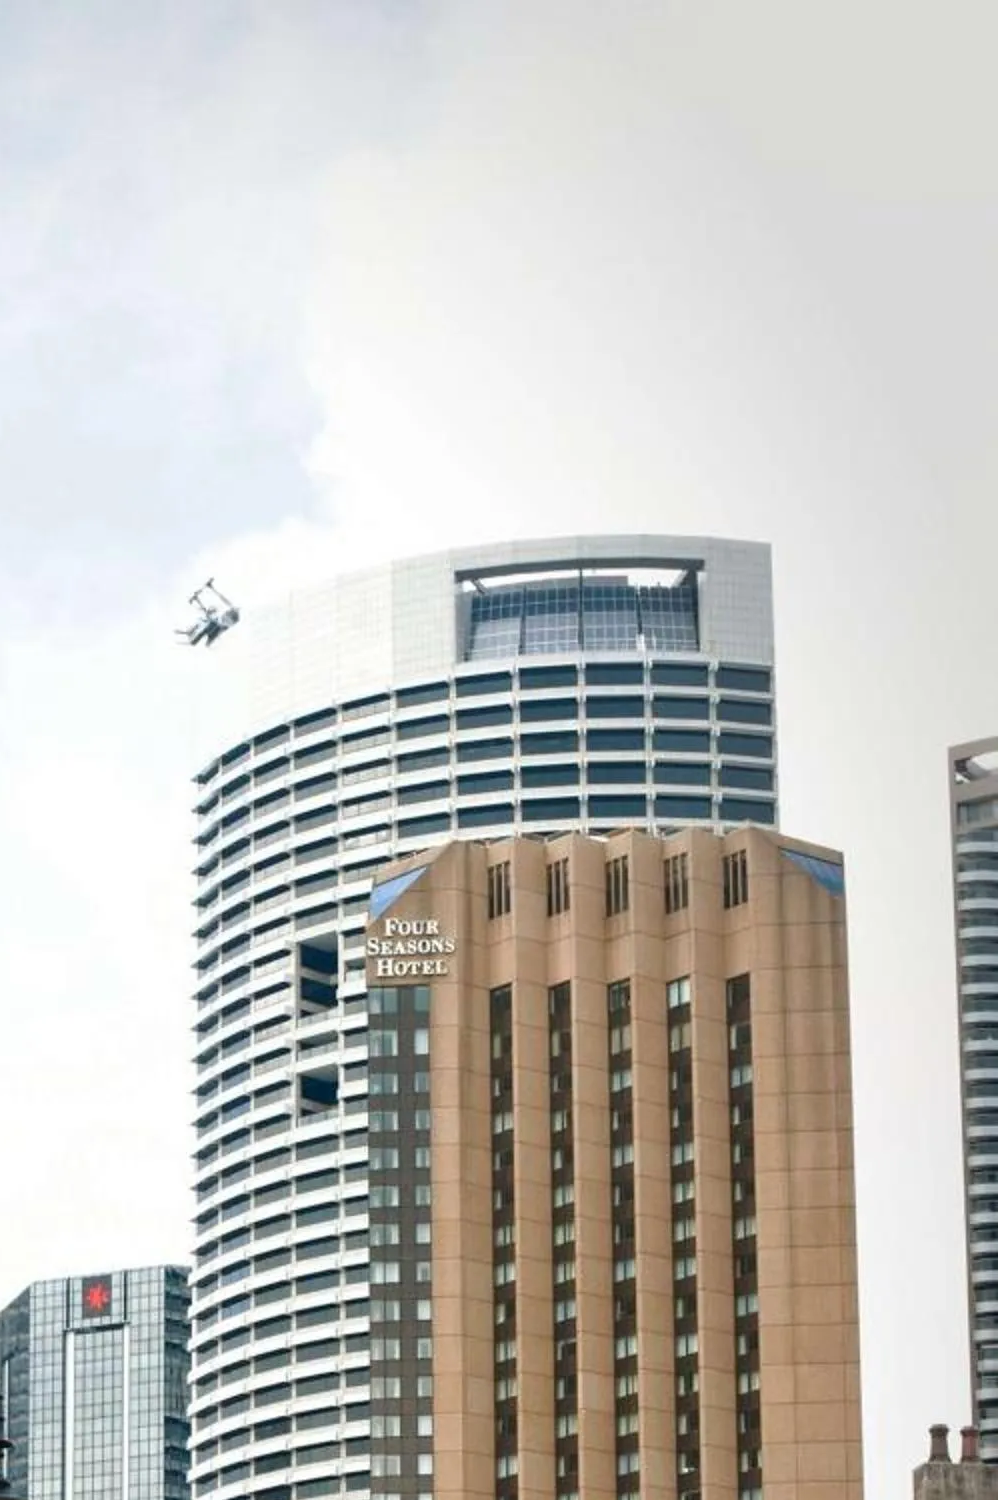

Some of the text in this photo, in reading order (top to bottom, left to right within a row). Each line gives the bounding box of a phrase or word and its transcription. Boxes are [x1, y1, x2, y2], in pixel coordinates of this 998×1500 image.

[385, 917, 439, 936] FOUR
[367, 937, 456, 955] SEASONS
[377, 958, 449, 977] HOTEL
